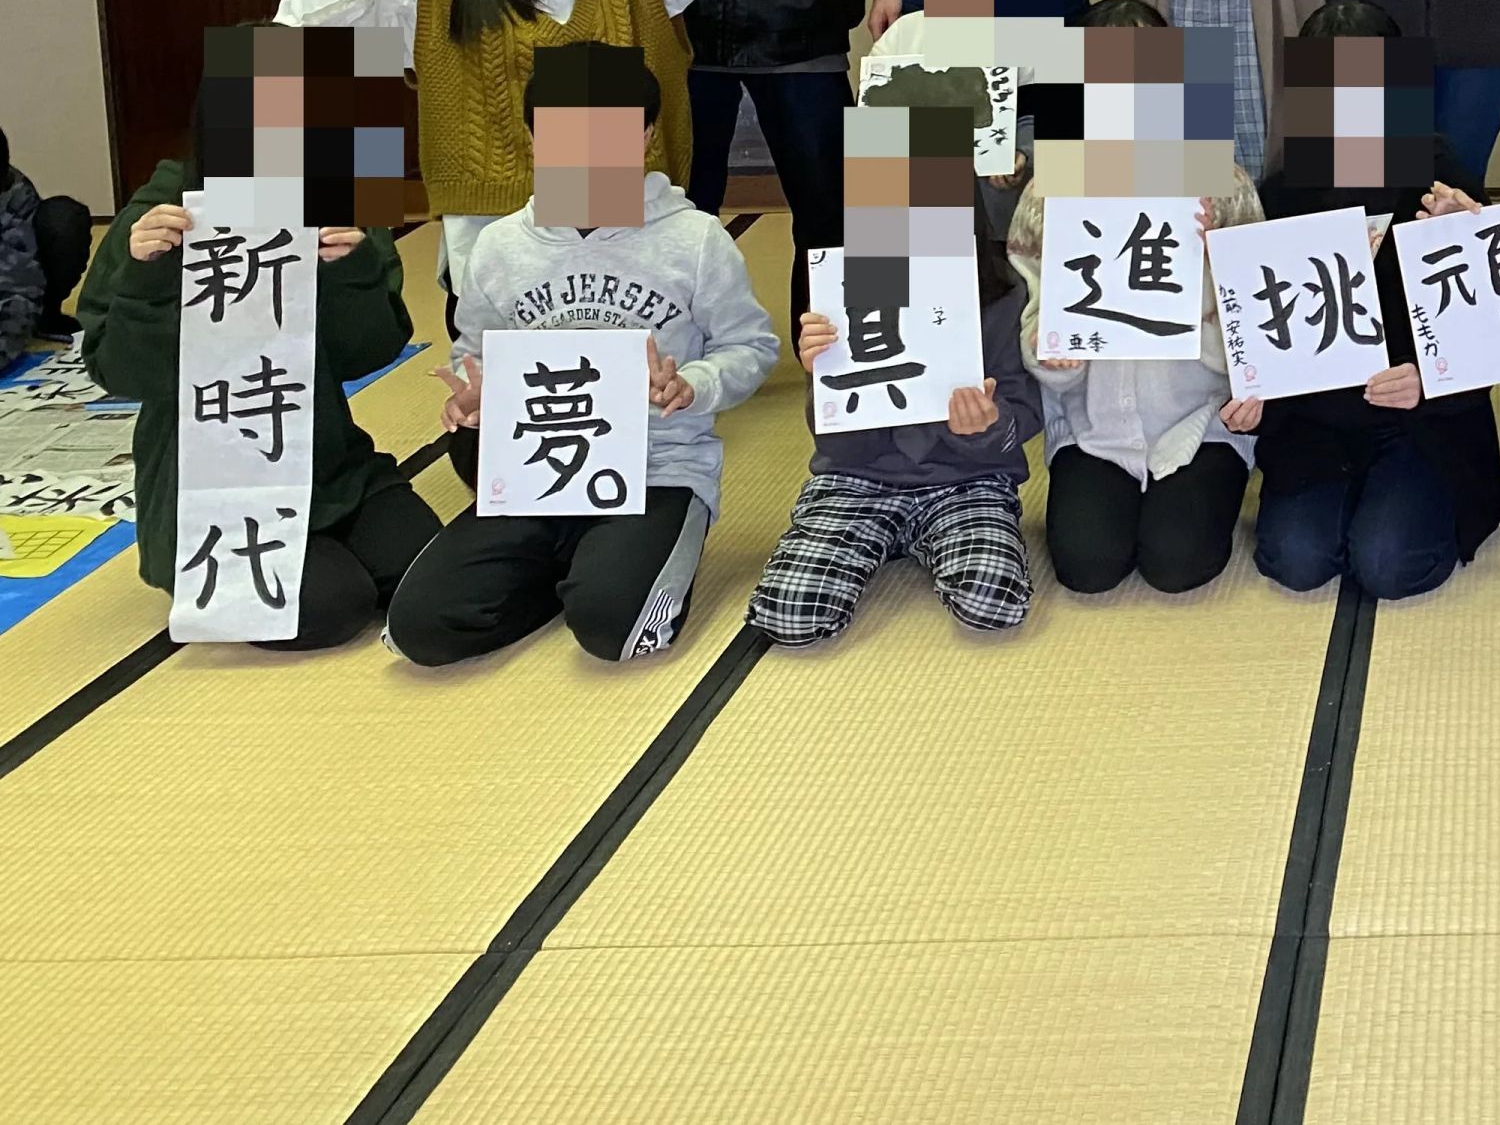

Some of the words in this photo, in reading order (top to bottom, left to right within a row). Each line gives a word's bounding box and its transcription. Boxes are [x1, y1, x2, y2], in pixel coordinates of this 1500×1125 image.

[551, 307, 600, 327] GARDEN
[560, 273, 683, 331] JERSEY
[1063, 211, 1199, 337] 進
[1252, 251, 1385, 356] 挑
[181, 226, 306, 611] 新時代
